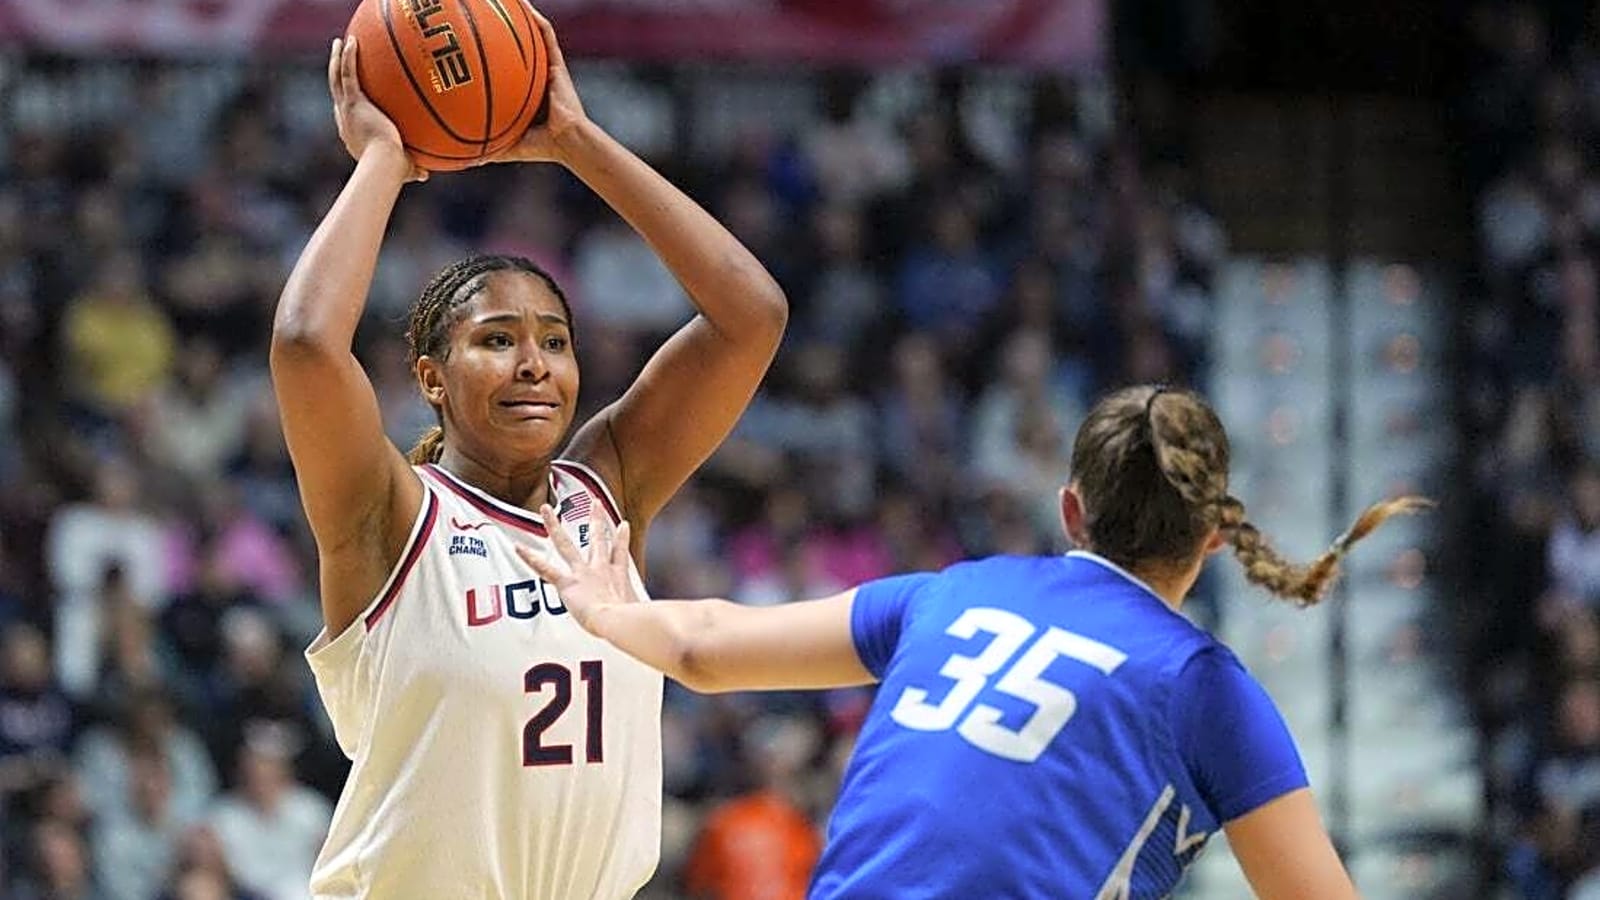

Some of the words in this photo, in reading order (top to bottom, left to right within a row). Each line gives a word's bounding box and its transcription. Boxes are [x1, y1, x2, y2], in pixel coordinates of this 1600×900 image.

[448, 545, 488, 558] CHANGE
[452, 535, 466, 545] BE
[466, 578, 568, 627] UCO
[890, 606, 1129, 763] 35
[522, 659, 604, 767] 21
